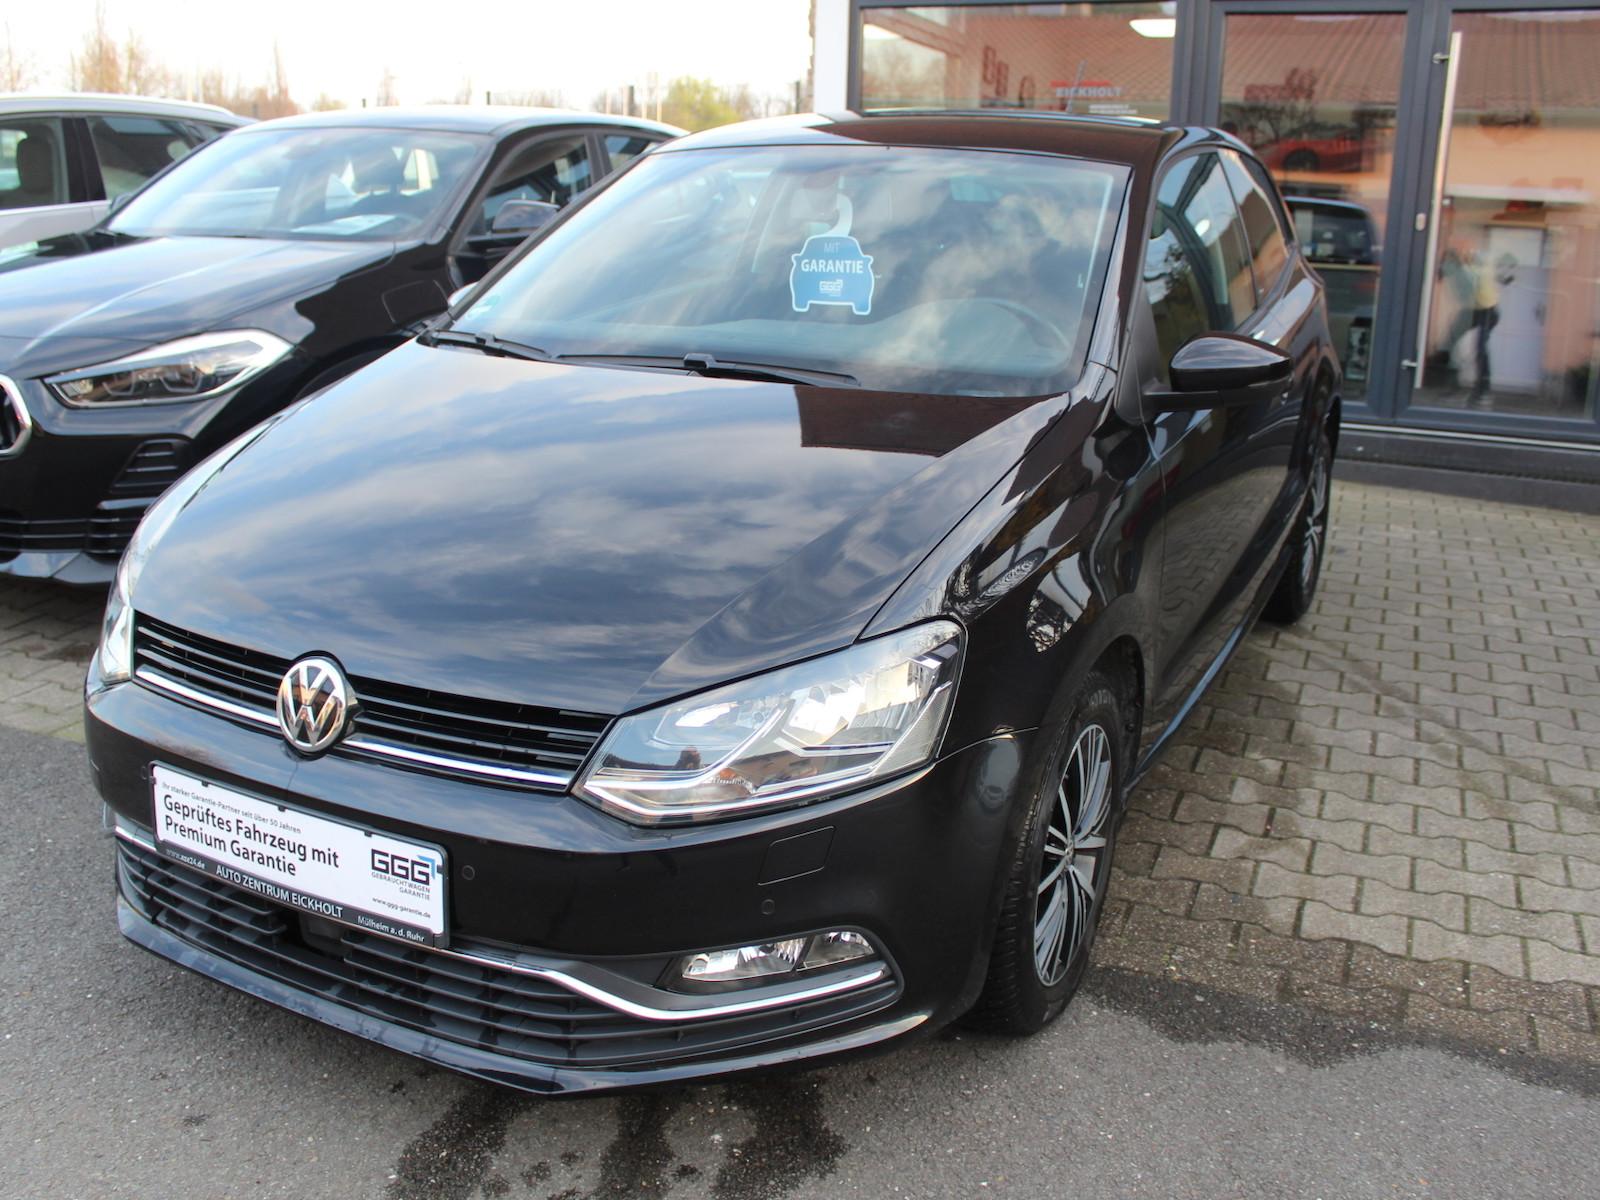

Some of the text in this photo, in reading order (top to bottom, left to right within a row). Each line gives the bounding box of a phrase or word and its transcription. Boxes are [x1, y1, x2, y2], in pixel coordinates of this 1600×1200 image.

[823, 242, 841, 253] MIT
[801, 259, 864, 273] GARANTIE
[162, 781, 302, 834] Ihr starker Garantie-Partner seit über 50 Jahren
[163, 794, 340, 868] Geprüftes Fahrzeug mit
[165, 815, 297, 877] Premium Garantie
[371, 848, 431, 886] GGG
[371, 871, 431, 893] GEBRAUCHTWAGEN
[215, 864, 344, 918] AUTO ZENTRUM EICKHOLT
[399, 886, 431, 901] GARANTIE
[357, 915, 390, 932] Mülheim
[406, 930, 425, 943] Ruhr
